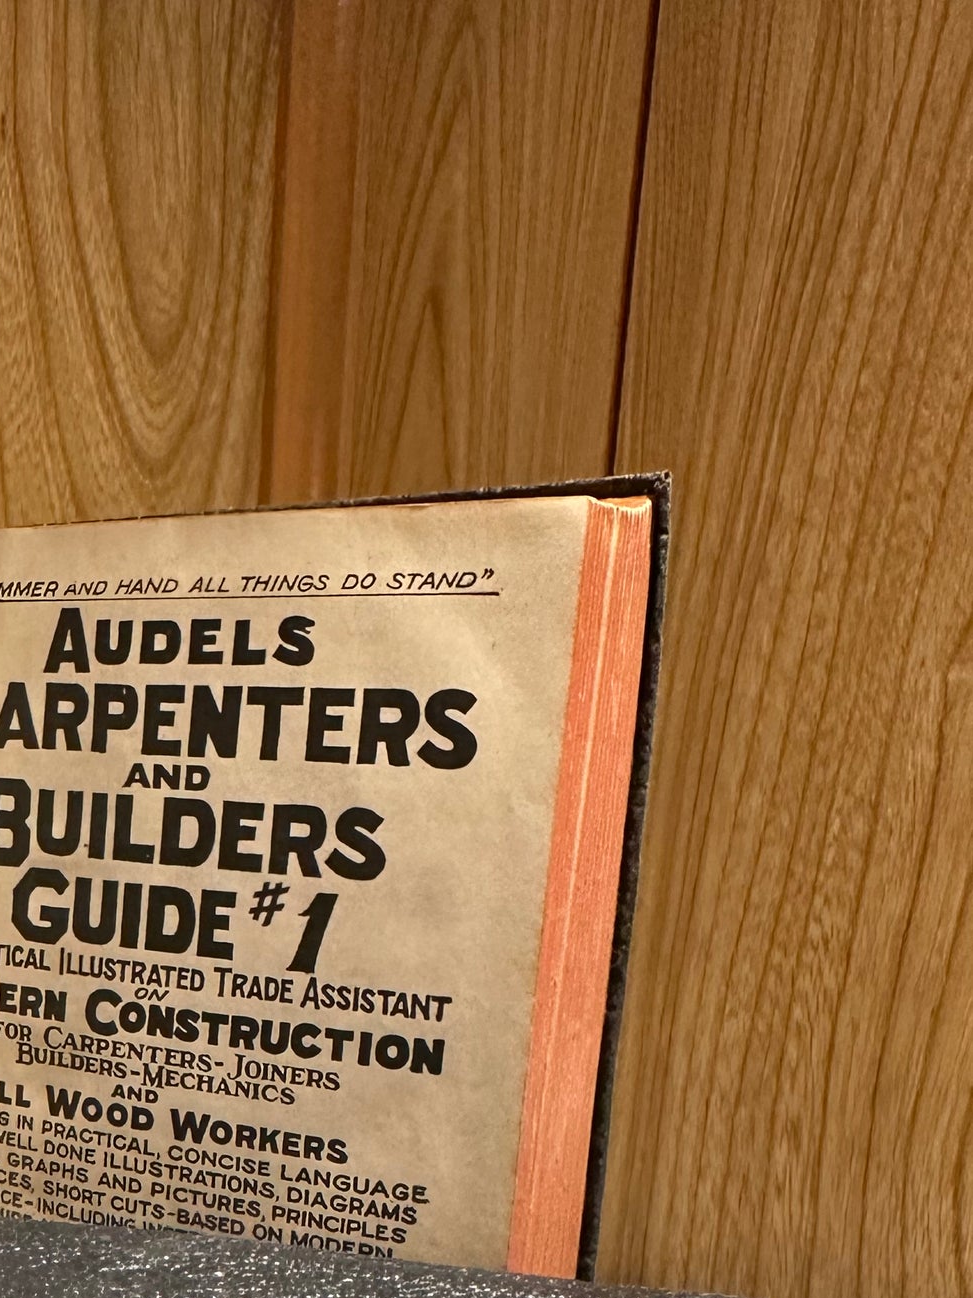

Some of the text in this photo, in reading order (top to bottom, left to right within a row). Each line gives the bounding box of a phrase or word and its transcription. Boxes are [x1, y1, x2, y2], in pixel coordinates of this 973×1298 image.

[64, 580, 107, 596] AND
[115, 577, 178, 595] HAND
[188, 576, 229, 593] ALL
[241, 574, 330, 592] THINGS
[341, 573, 376, 590] DO
[43, 607, 316, 674] AUDELS
[123, 762, 211, 792] AND
[11, 866, 238, 961] GUIDE
[59, 947, 205, 993] ILLUSTRATED
[214, 967, 294, 1004] TRADE
[300, 976, 452, 1023] ASSISTANT
[134, 986, 170, 1002] ON
[85, 988, 445, 1076] CONSTRUCTION
[45, 1084, 155, 1131] WOOD
[170, 1108, 349, 1164] WORKERS
[111, 1084, 159, 1104] AND
[17, 1114, 34, 1132] IN
[41, 1120, 161, 1161] PRACTICAL,
[167, 1145, 271, 1177] CONCISE
[280, 1164, 430, 1205] LANGUAGE
[44, 1139, 96, 1165] DONE
[103, 1151, 280, 1202] ILLUSTRATIONS,
[287, 1186, 418, 1226] DIAGRAMS
[7, 1152, 89, 1183] GRAPHS
[97, 1172, 142, 1194] AND
[150, 1182, 266, 1223] PICTURES,
[271, 1205, 407, 1244] PRINCIPLES
[43, 1180, 106, 1207] SHORT
[252, 1223, 283, 1243] ON
